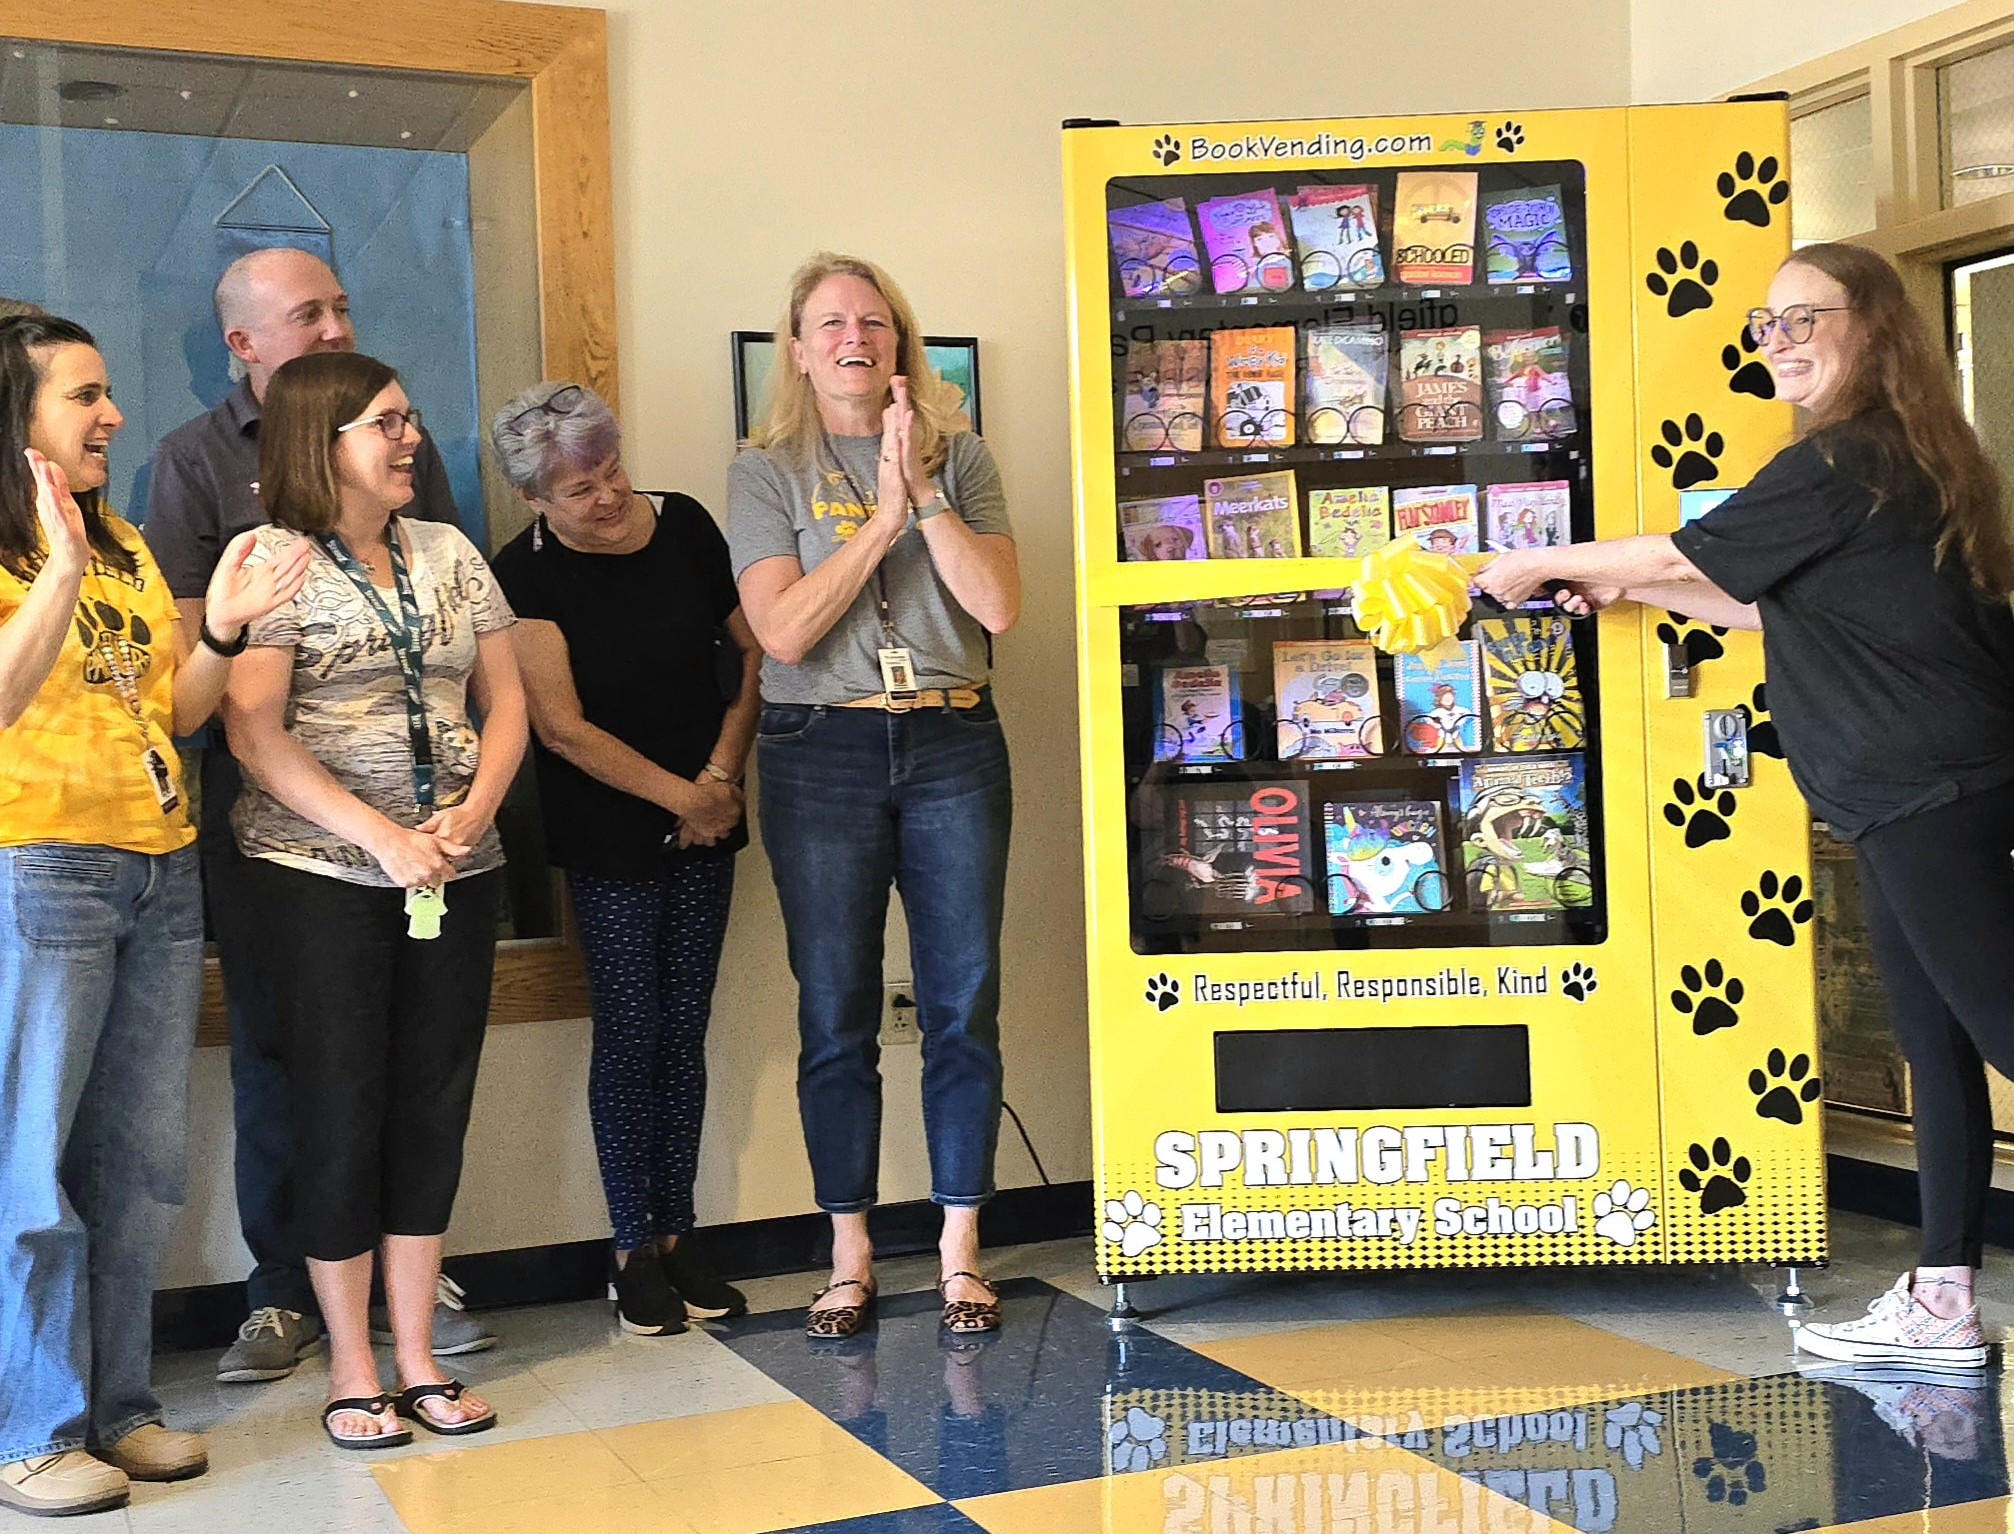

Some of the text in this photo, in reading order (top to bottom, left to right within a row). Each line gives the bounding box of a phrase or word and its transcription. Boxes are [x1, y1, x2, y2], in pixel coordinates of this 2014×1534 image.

[1191, 134, 1431, 160] BookVending.com
[1396, 247, 1469, 264] SCHOOLED
[1415, 382, 1468, 398] JAMES
[1213, 495, 1290, 516] Meerkats
[1250, 787, 1302, 905] OLIVIA
[1194, 966, 1548, 1006] Respectful, Responsible, Kind
[1154, 1122, 1601, 1189] SPRINGFIELD
[1180, 1195, 1579, 1246] Elementary School
